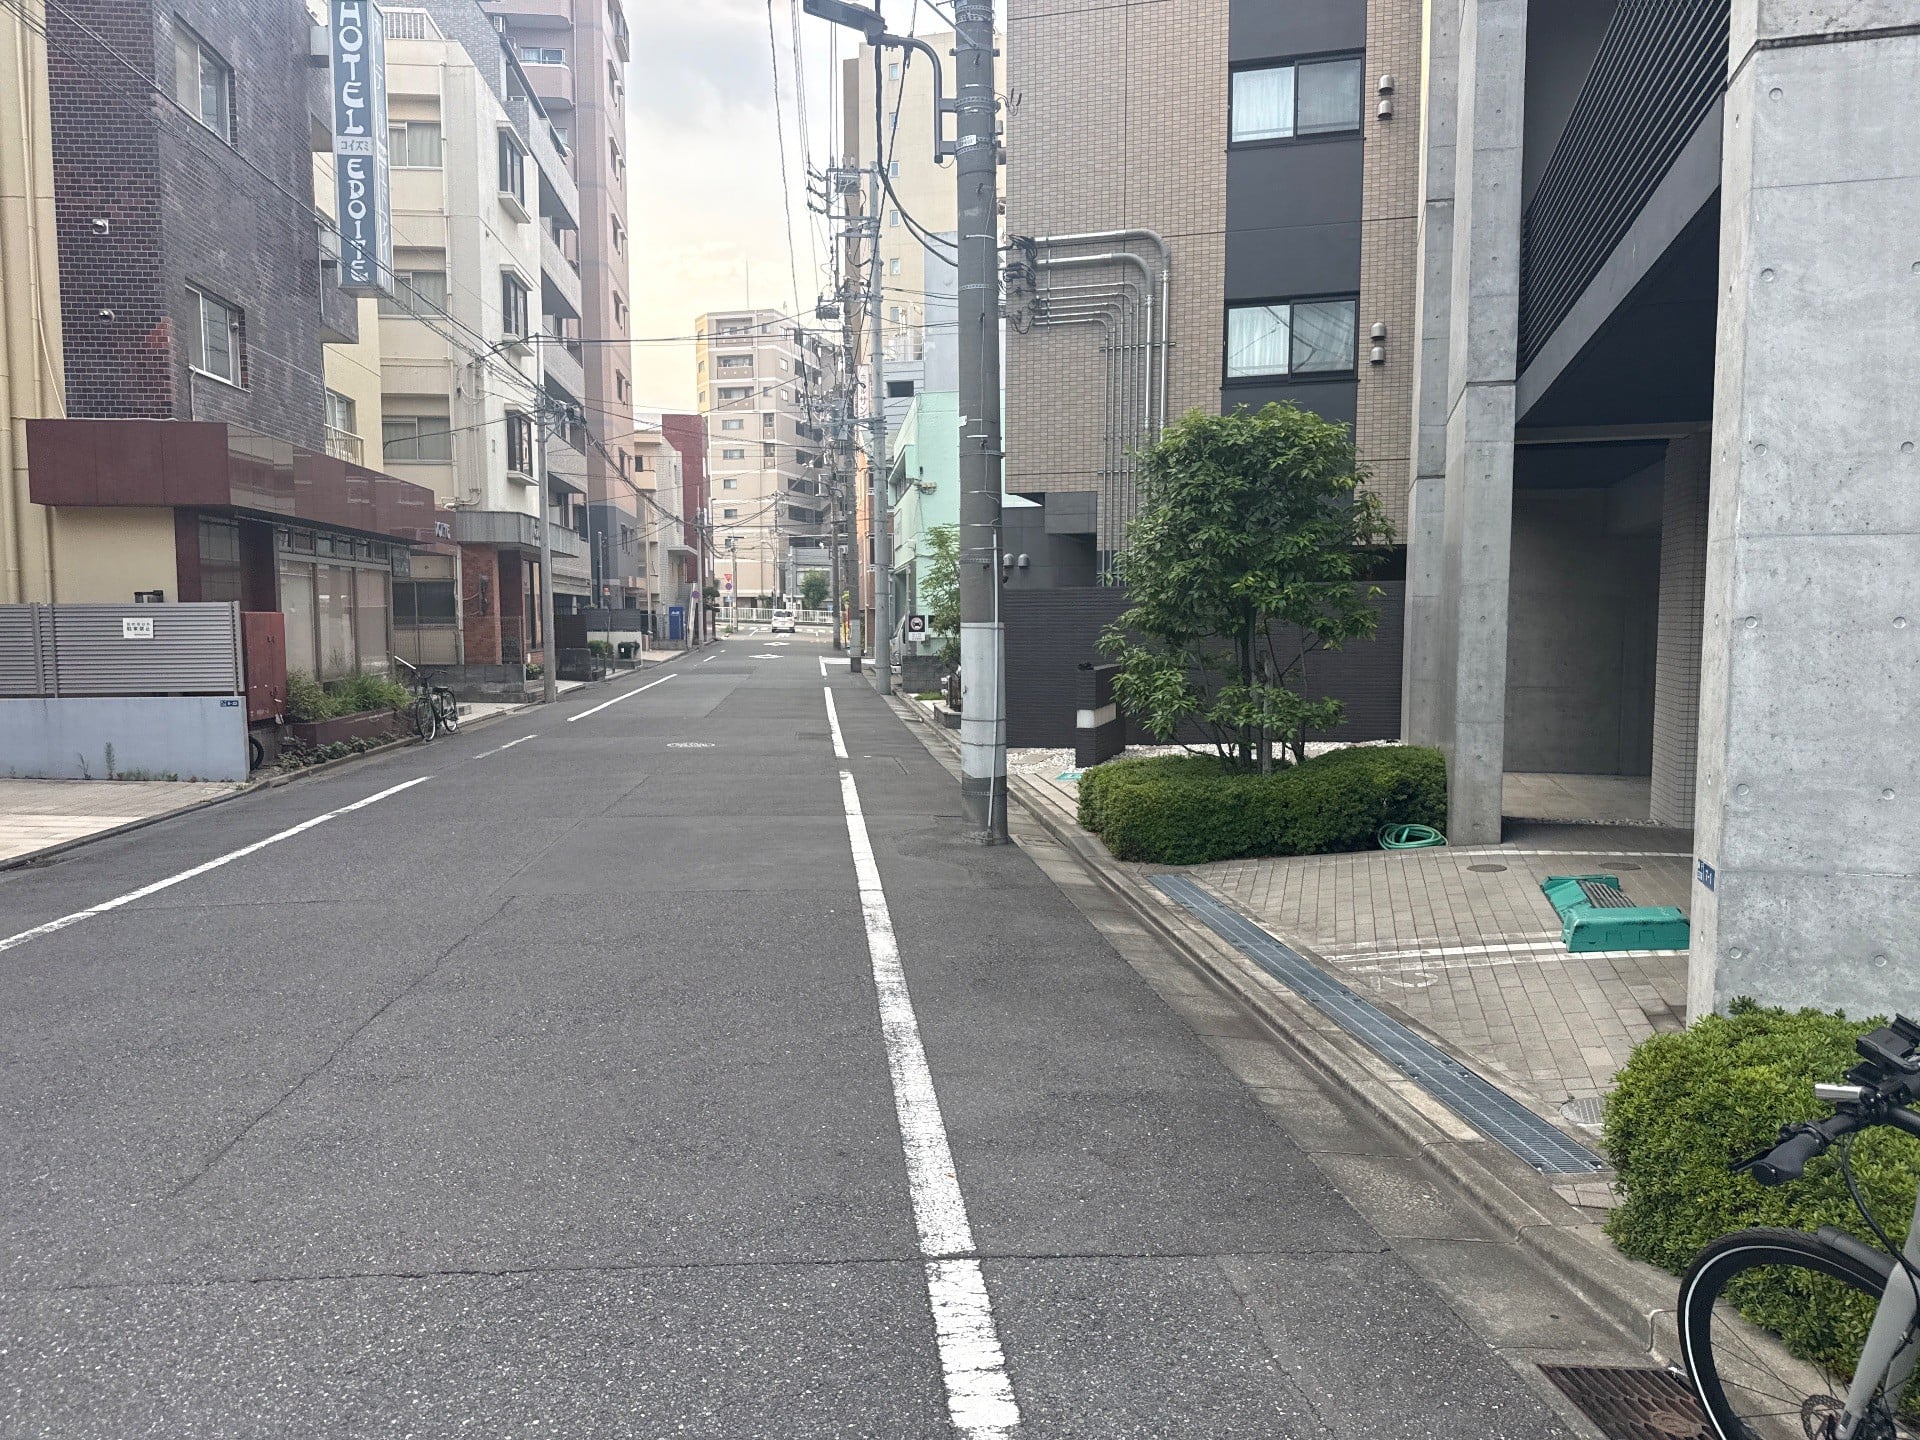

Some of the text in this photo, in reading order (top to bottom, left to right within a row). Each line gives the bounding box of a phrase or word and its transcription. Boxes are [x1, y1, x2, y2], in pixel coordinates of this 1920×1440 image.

[339, 2, 365, 135] HOTEL
[340, 140, 369, 151] コイズミ
[347, 158, 369, 282] EDOITE
